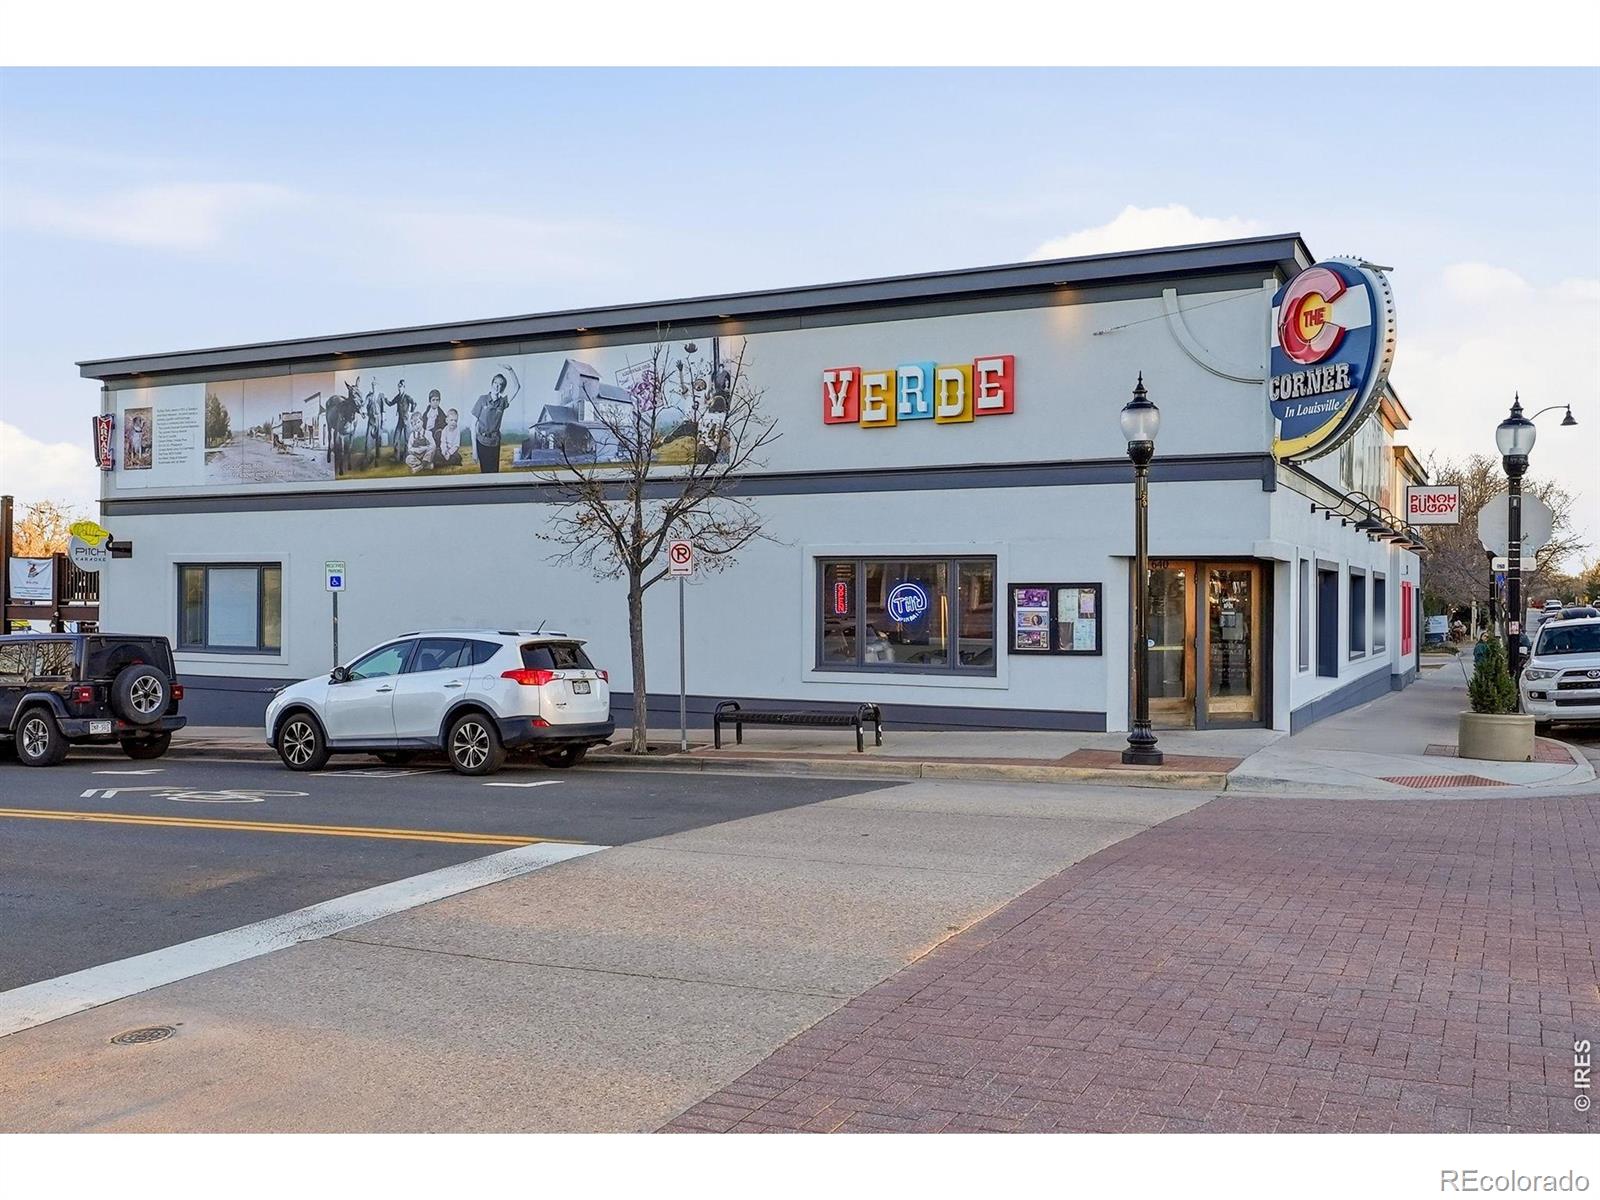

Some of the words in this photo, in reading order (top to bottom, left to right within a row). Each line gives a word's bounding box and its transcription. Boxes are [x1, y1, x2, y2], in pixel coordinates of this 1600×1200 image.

[1303, 306, 1327, 328] THE
[823, 358, 1004, 421] VERDE
[1269, 362, 1350, 401] CORNER
[1284, 406, 1295, 418] In
[1297, 399, 1341, 416] Louisville
[100, 422, 108, 459] ARCADE
[1410, 503, 1456, 513] BUGGY
[75, 547, 107, 556] PITCH
[837, 584, 845, 612] OPEN
